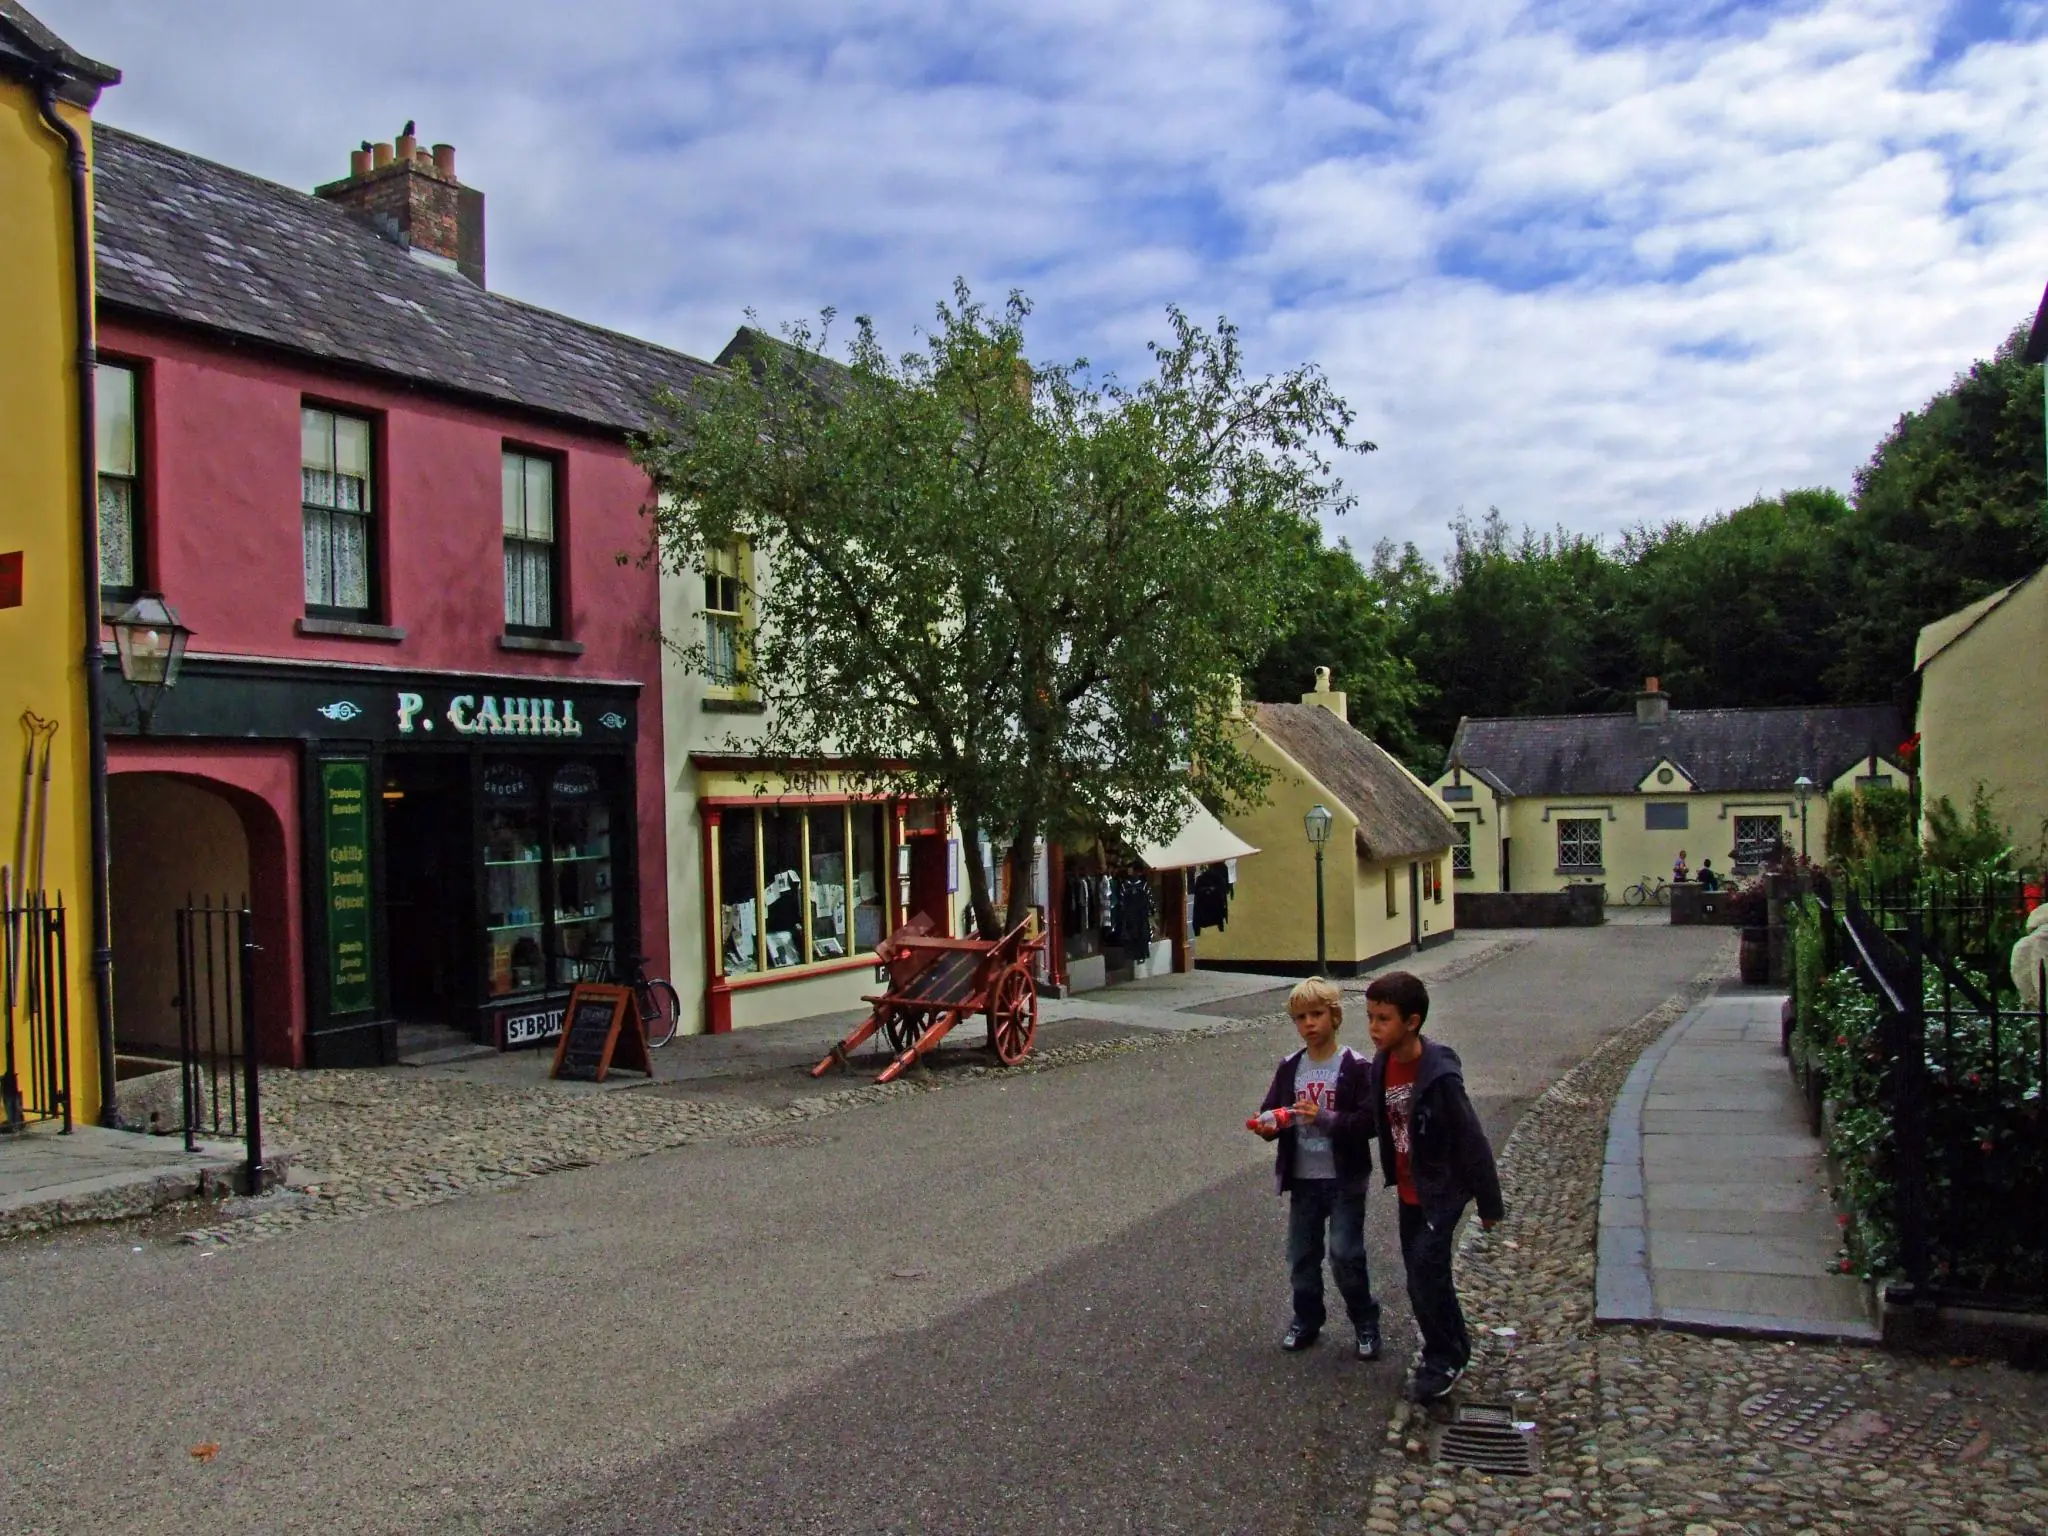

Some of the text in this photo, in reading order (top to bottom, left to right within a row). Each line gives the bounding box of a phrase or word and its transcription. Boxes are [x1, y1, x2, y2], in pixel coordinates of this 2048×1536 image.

[398, 692, 583, 738] P. CAHILL
[483, 781, 525, 796] GROCER
[784, 771, 831, 793] JOHN
[526, 1010, 564, 1036] BRUN
